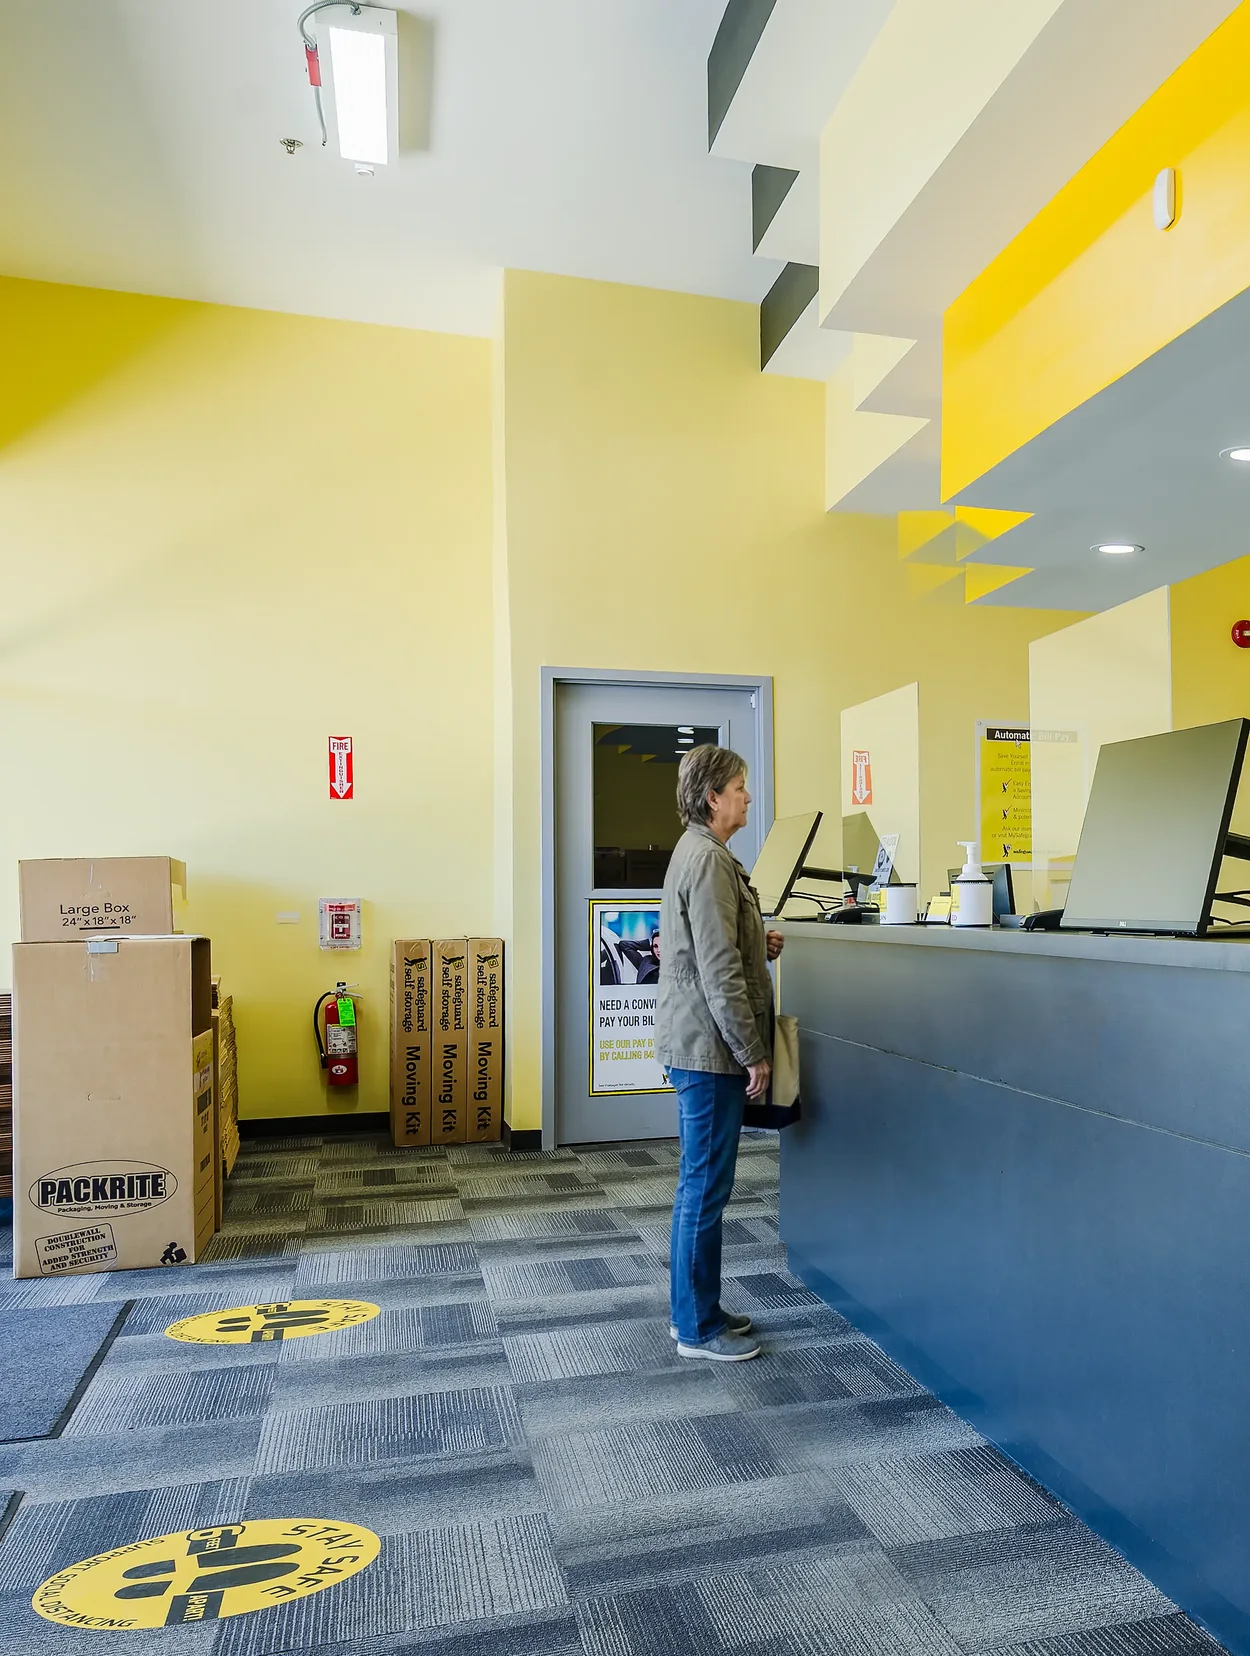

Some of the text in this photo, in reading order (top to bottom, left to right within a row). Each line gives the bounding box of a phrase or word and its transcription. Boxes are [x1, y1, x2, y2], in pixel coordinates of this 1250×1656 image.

[994, 729, 1036, 741] Automatc
[332, 741, 349, 751] FIRE
[60, 902, 130, 917] Large Box
[84, 918, 91, 926] x
[402, 968, 416, 1033] self storage
[415, 976, 428, 1032] safeguard
[439, 966, 453, 1031] self storage
[452, 975, 465, 1031] safeguard
[474, 964, 488, 1029] self storage
[486, 973, 500, 1029] safeguard
[599, 999, 622, 1011] NEED
[623, 998, 630, 1011] A
[599, 1016, 616, 1028] PAY
[617, 1015, 640, 1027] YOUR
[599, 1040, 614, 1050] USE
[615, 1039, 631, 1049] OUR
[632, 1038, 646, 1049] PAY
[599, 1052, 611, 1061] BY
[612, 1050, 642, 1061] CALLING
[402, 1045, 421, 1136] Moving Kit
[438, 1044, 458, 1133] Moving Kit
[473, 1041, 493, 1131] Moving Kit
[38, 1171, 168, 1207] PACKRITE
[44, 1233, 106, 1252] CONSTRUCTION
[47, 1228, 101, 1245] DOUBLEWALL
[42, 1244, 114, 1266] ADDED STRENGTH
[68, 1244, 86, 1253] FOR
[50, 1252, 109, 1271] AND SECURITY
[205, 1536, 221, 1550] FEET
[260, 1523, 365, 1599] STAY SAFE
[38, 1538, 165, 1628] SUPPORT SOCIAL DISTANCING
